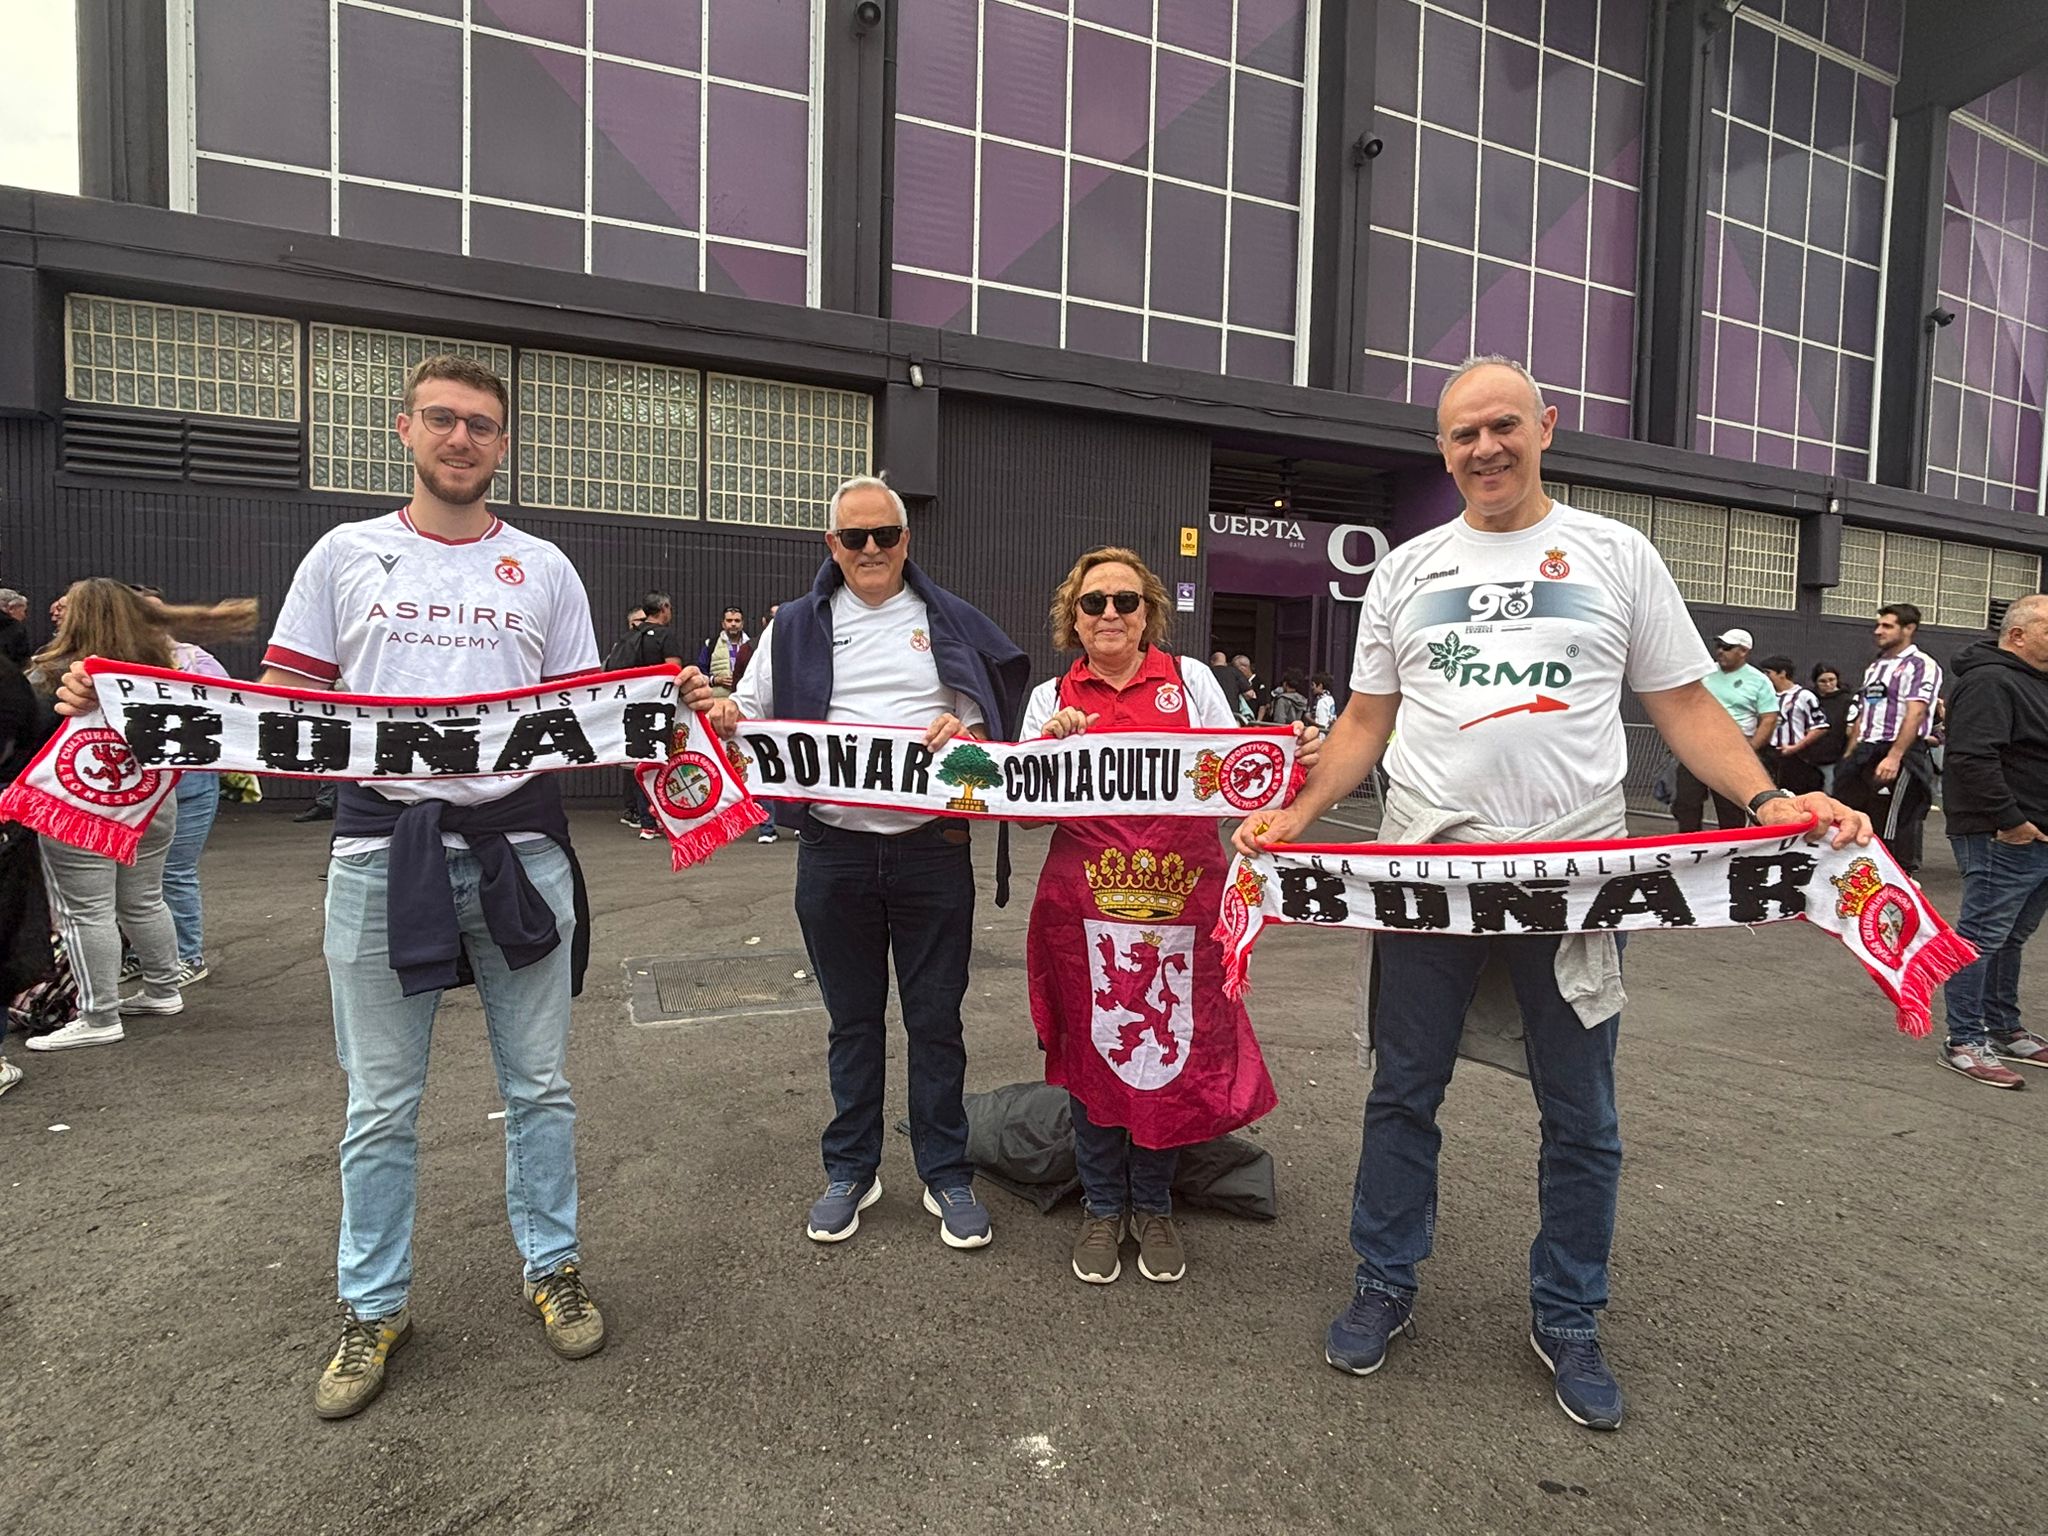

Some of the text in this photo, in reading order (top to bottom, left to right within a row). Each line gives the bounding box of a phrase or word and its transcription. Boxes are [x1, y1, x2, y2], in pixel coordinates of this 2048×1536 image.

[1208, 513, 1391, 601] UERTA 9
[386, 631, 500, 650] ACADEMY
[116, 678, 245, 706] PEÑA
[1458, 661, 1572, 688] RMD
[61, 731, 120, 760] CULTURAL
[120, 702, 677, 774] BOÑAR
[743, 732, 1181, 803] BOÑAR CON LA CULTU
[1222, 743, 1270, 771] DEPORTIVA
[58, 763, 139, 804] LEONESA
[1273, 851, 1819, 934] BOÑAR
